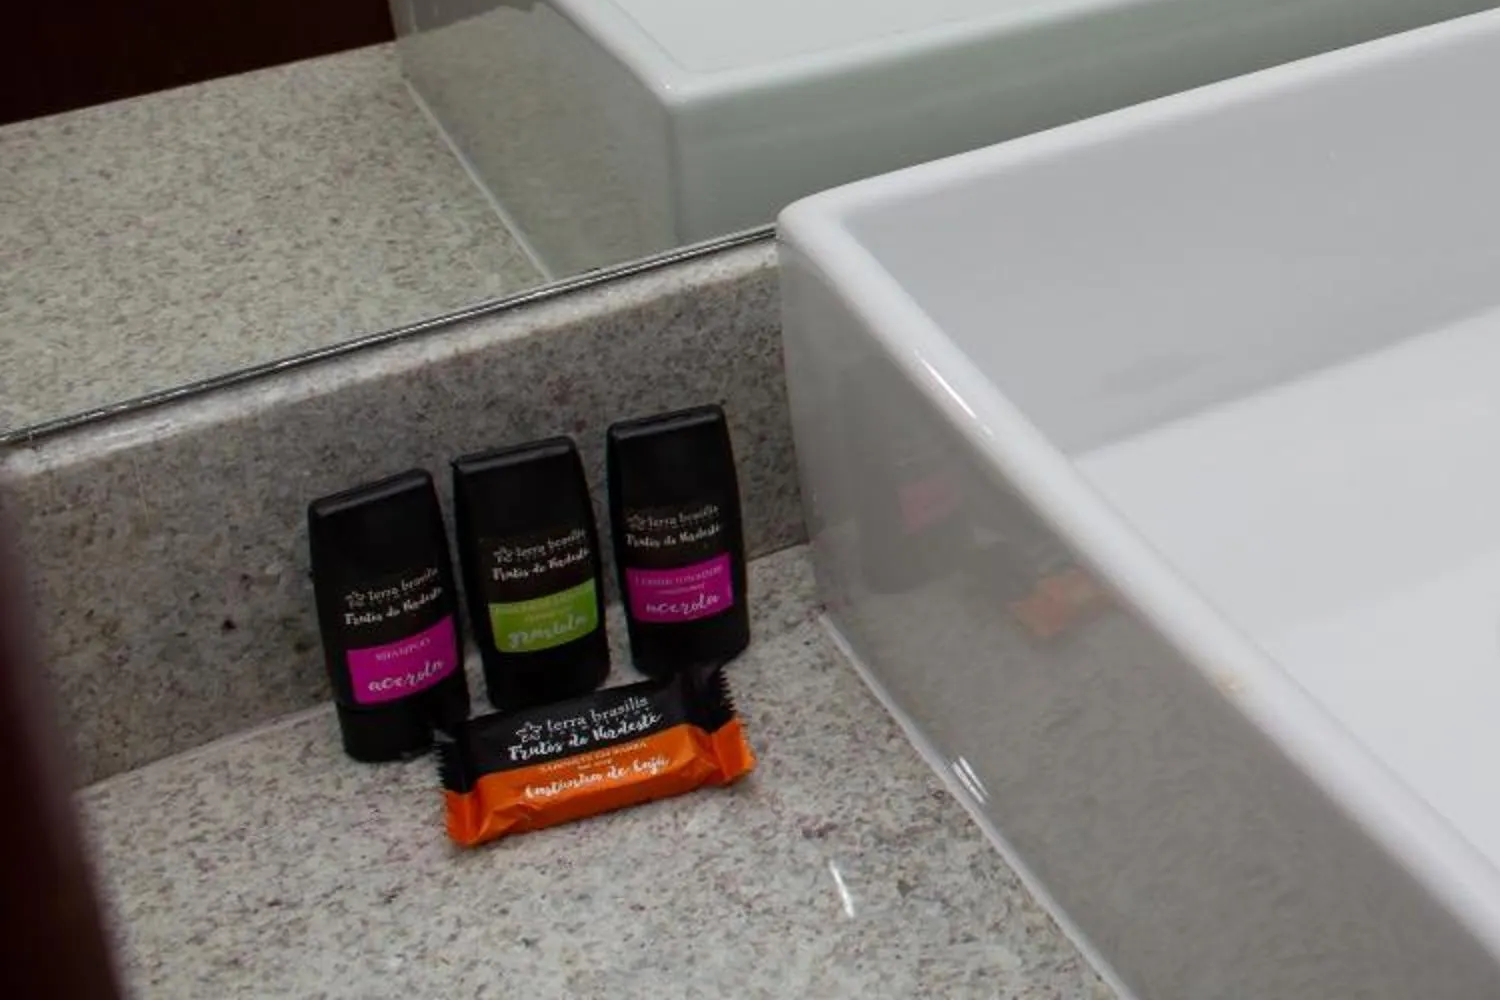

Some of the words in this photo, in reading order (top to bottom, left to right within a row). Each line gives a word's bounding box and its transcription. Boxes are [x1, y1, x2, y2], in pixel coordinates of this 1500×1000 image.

[646, 593, 720, 615] acerola
[367, 659, 445, 691] acerola
[546, 715, 588, 732] terra
[590, 696, 650, 722] brasilis
[508, 740, 563, 761] Frutos
[568, 733, 589, 747] do
[593, 712, 663, 741] Nordeste
